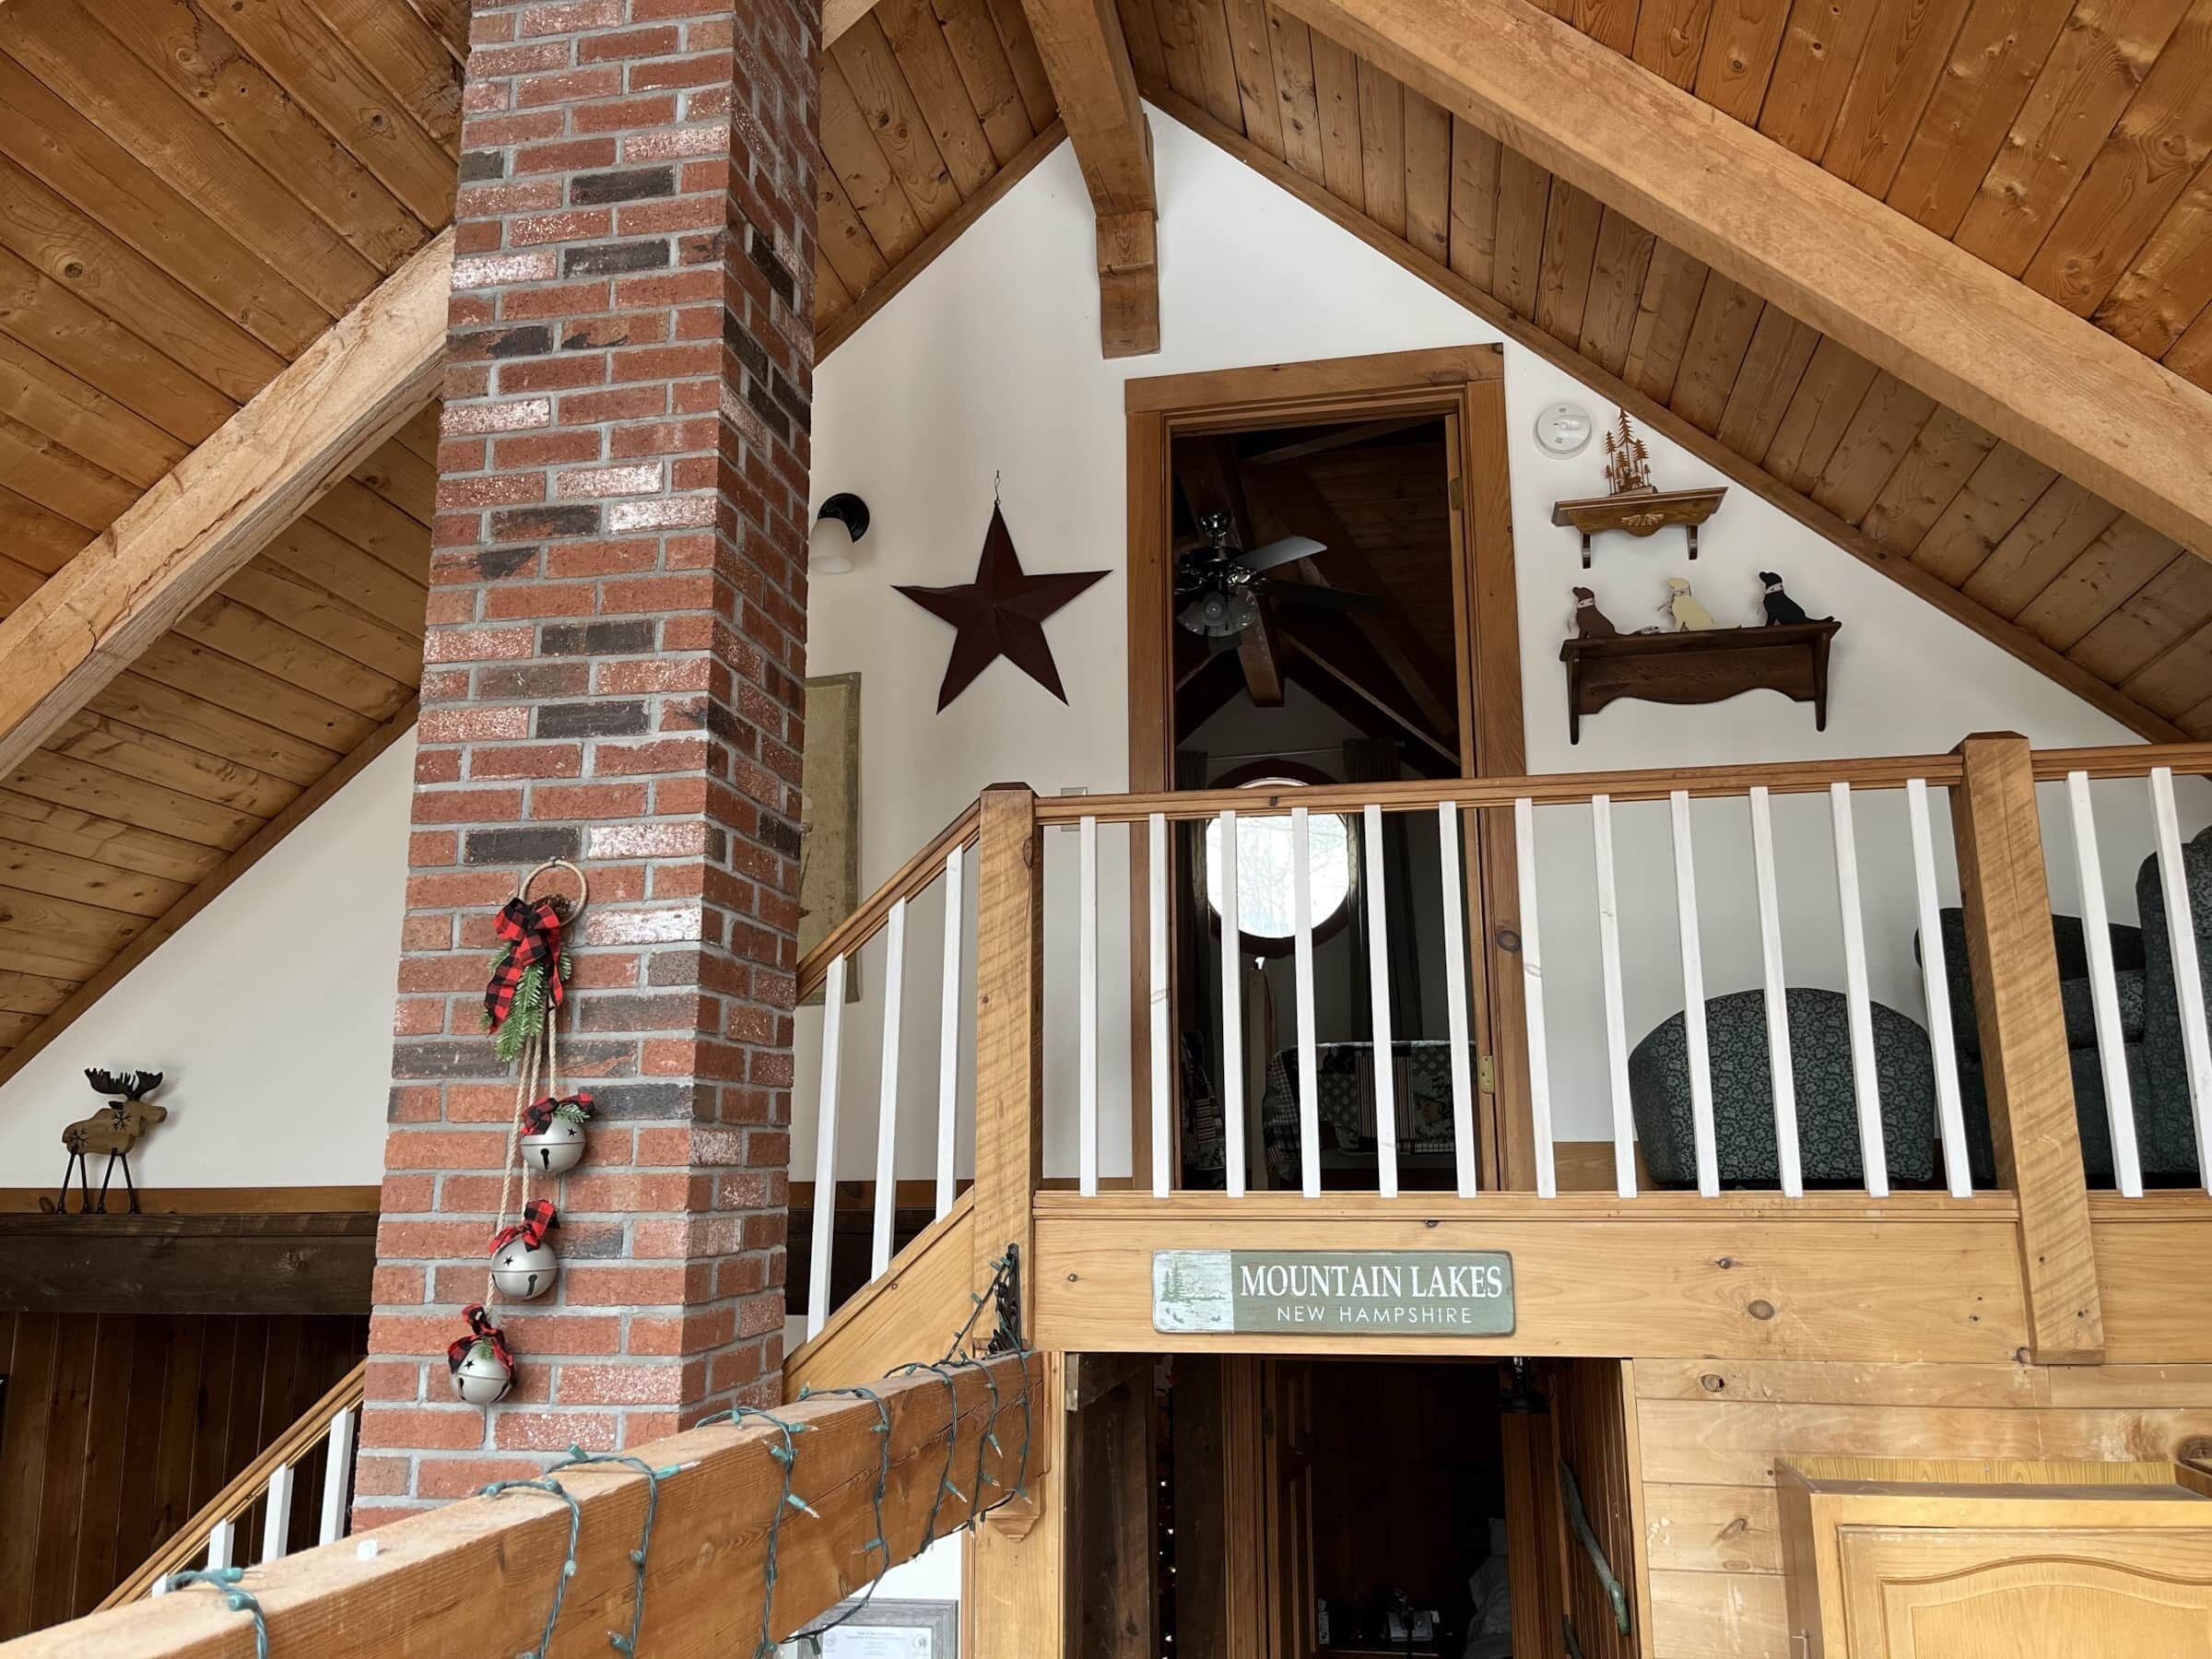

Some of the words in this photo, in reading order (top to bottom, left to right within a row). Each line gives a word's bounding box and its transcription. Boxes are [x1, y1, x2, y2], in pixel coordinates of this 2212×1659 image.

[1240, 1265, 1402, 1298] MOUNTAIN
[1408, 1265, 1503, 1299] LAKES
[1277, 1305, 1324, 1322] NEW
[1339, 1305, 1472, 1324] HAMPSHIRE
